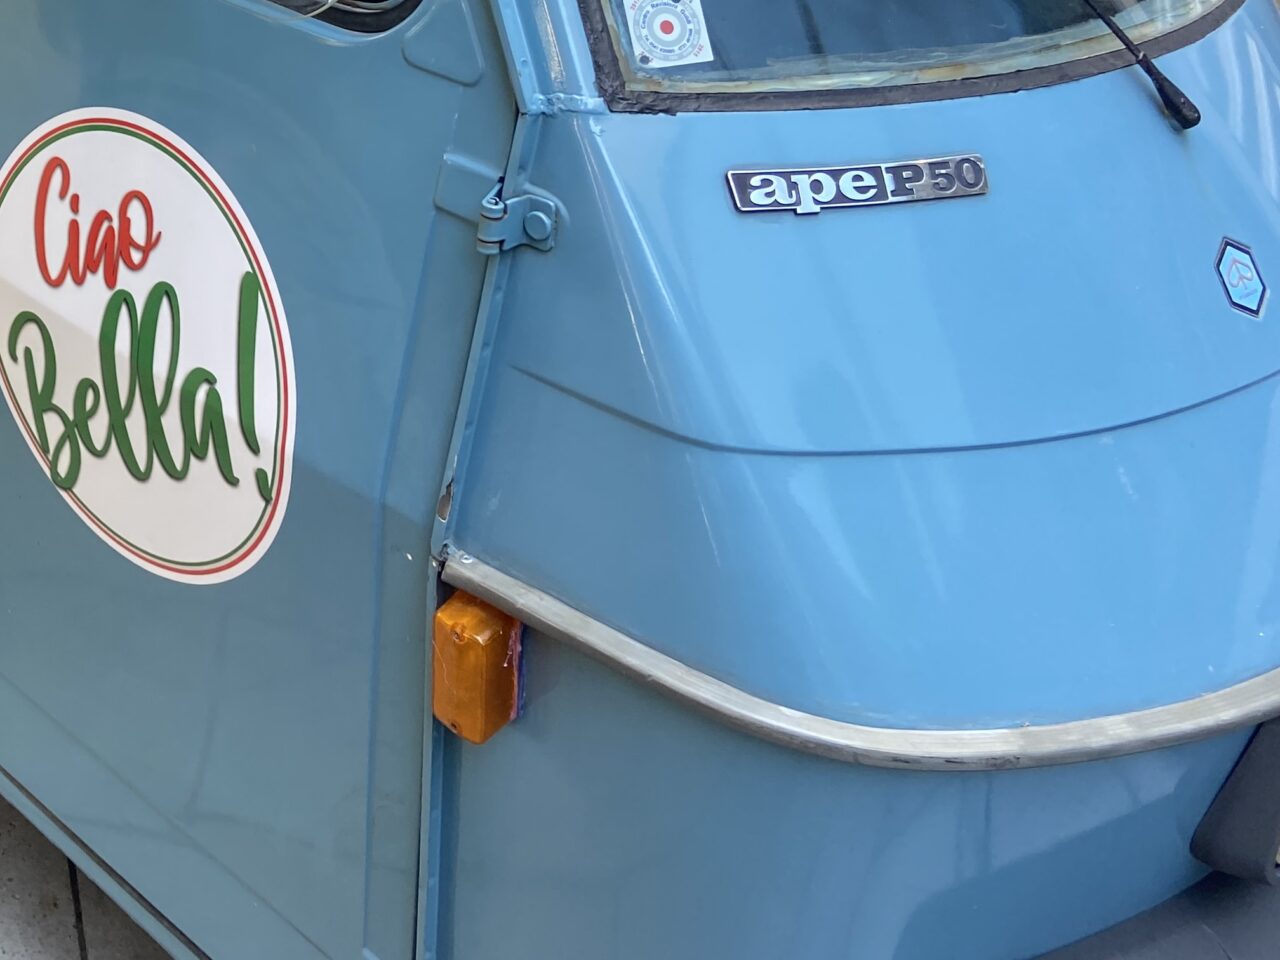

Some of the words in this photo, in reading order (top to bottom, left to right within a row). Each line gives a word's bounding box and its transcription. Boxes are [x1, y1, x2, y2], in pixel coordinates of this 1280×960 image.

[33, 156, 161, 289] Ciao
[749, 170, 878, 214] ape
[885, 157, 985, 198] P50
[8, 271, 272, 504] Bella!
